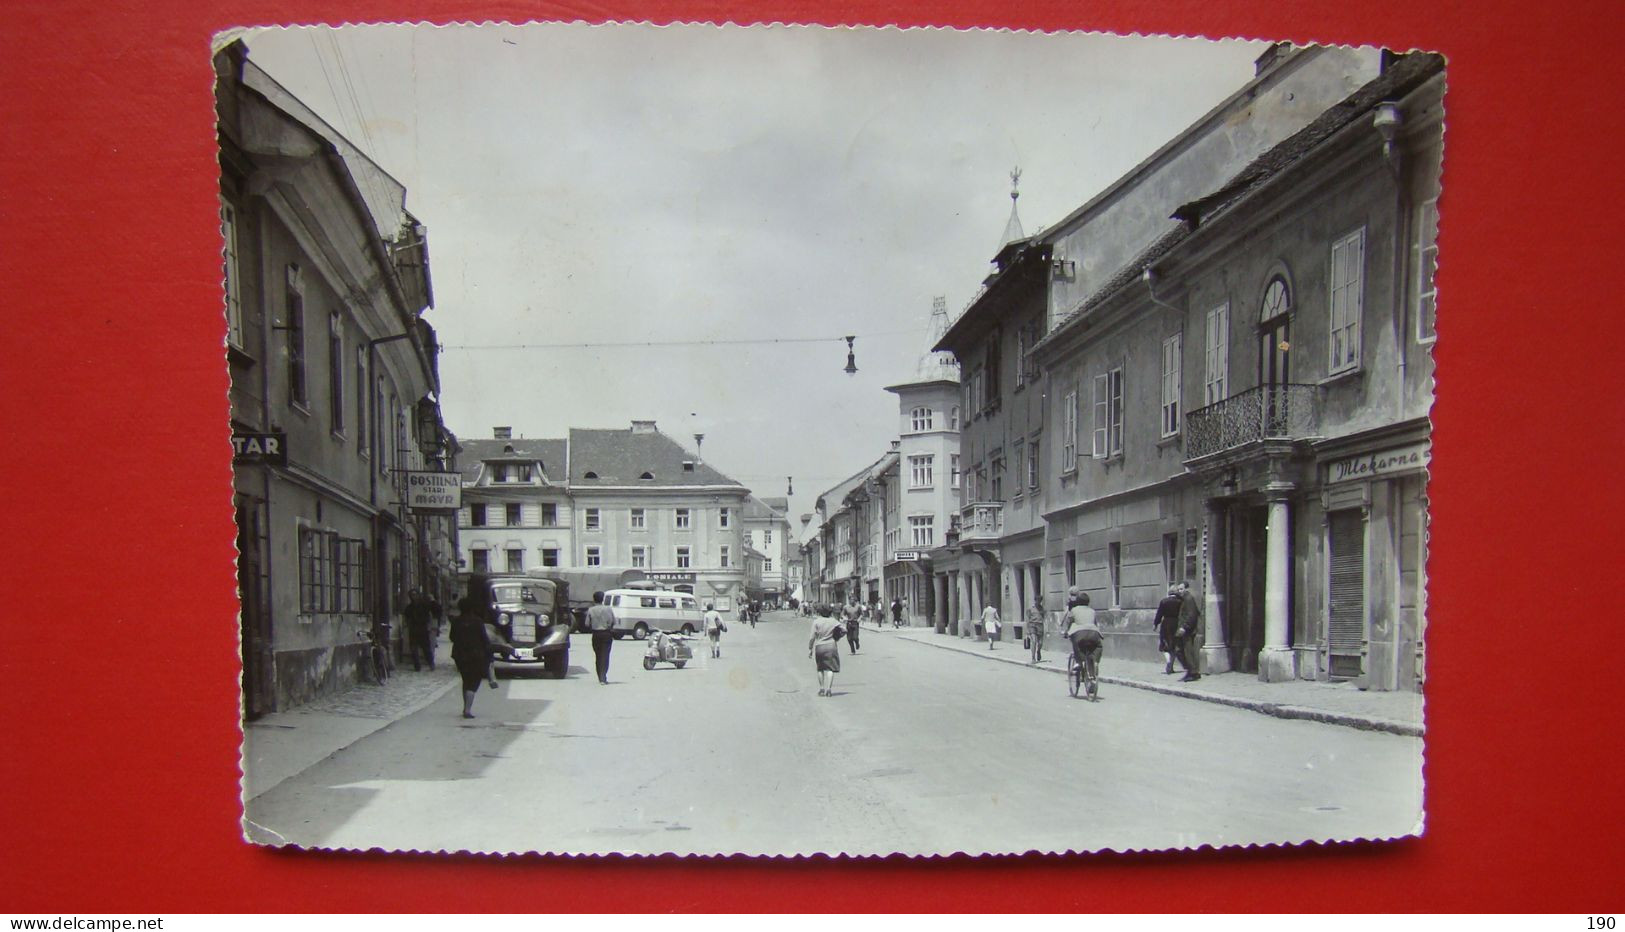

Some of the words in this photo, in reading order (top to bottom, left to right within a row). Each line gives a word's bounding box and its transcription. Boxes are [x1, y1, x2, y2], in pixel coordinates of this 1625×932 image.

[232, 437, 280, 455] TAR
[1336, 452, 1419, 481] Mlekarna
[410, 475, 459, 487] GOSTILNA
[423, 486, 446, 494] STARI
[415, 495, 454, 504] MAYR
